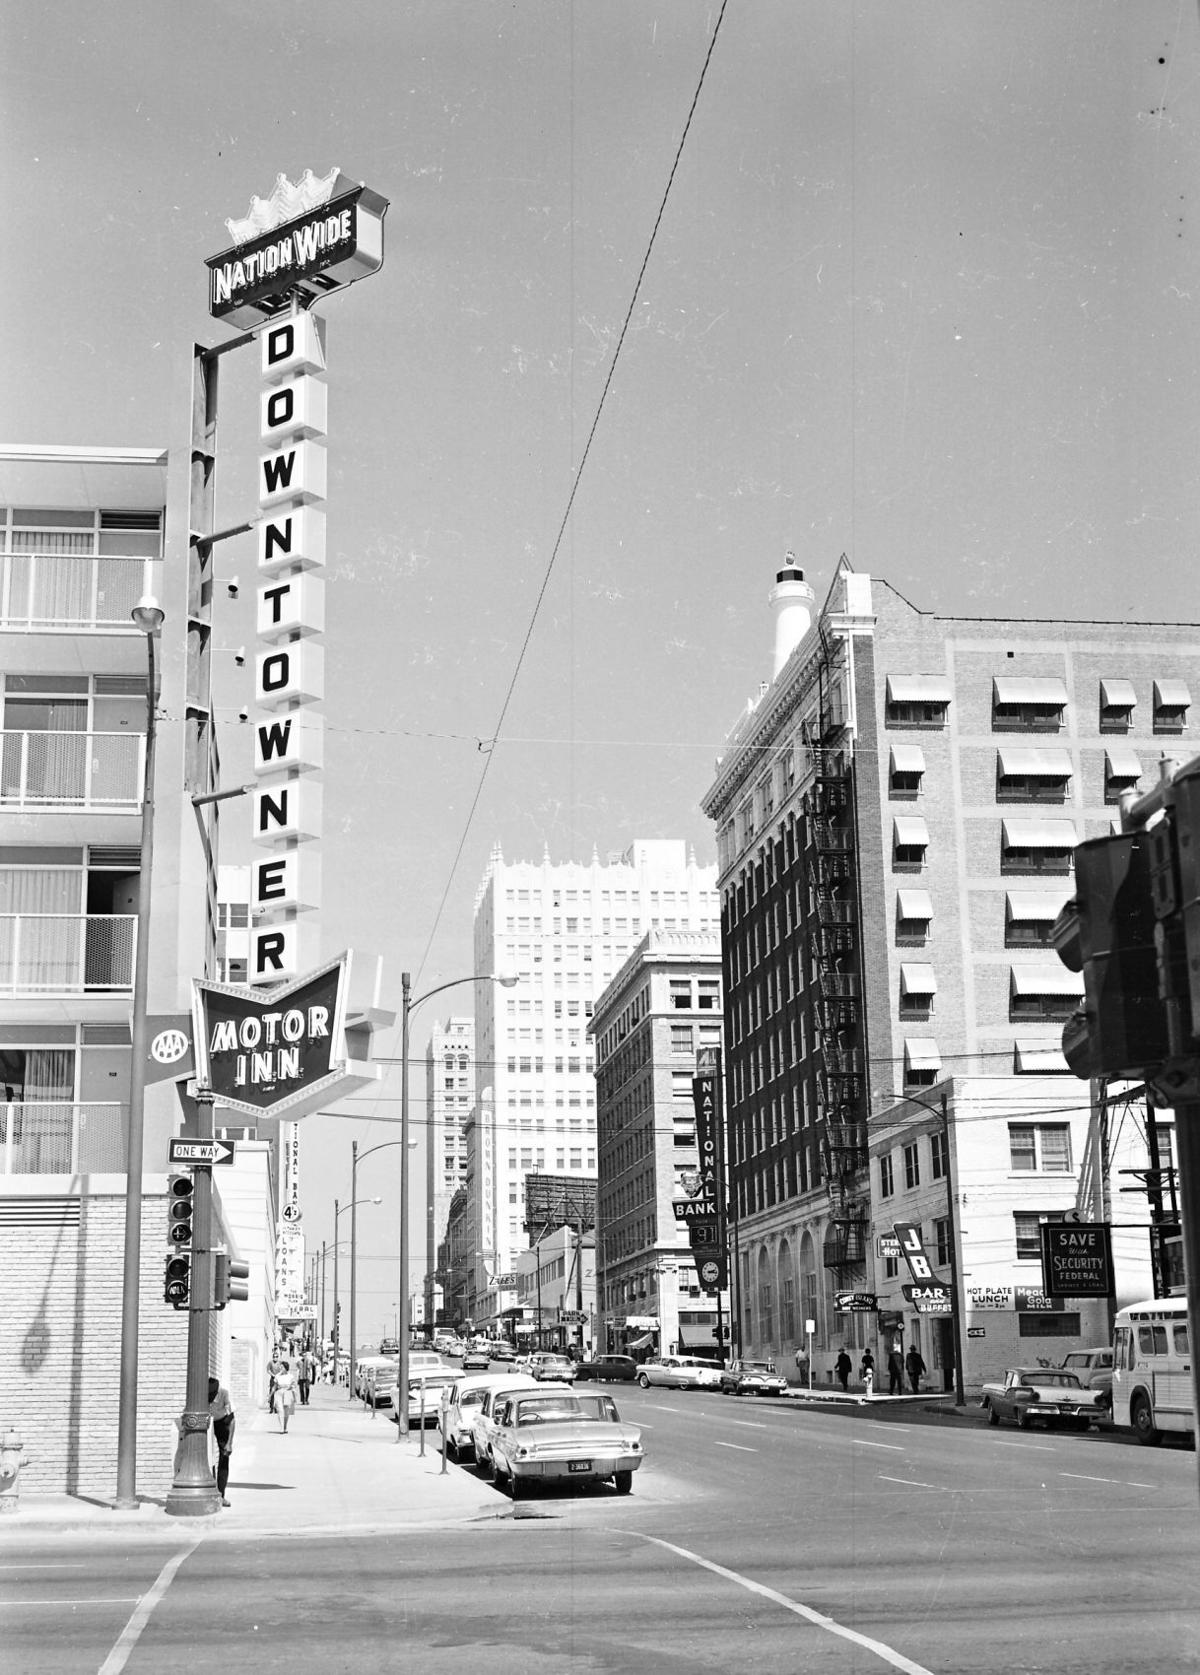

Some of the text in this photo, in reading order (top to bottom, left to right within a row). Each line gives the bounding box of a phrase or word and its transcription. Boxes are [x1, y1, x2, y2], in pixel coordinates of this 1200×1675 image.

[257, 324, 297, 973] DOWNTOWNER
[209, 1005, 330, 1053] MOTOR
[155, 1032, 186, 1059] AAA
[236, 1046, 300, 1086] INN
[701, 1081, 715, 1197] NATIONAL
[175, 1145, 220, 1158] ONE WAY
[675, 1201, 717, 1216] BANK
[1059, 1233, 1096, 1246] SAVE
[1053, 1255, 1104, 1271] SECURITY
[1059, 1272, 1100, 1281] FEDERAL
[911, 1288, 945, 1299] BAR
[966, 1287, 1013, 1295] HOT PLATE
[971, 1295, 1009, 1303] LUNCH
